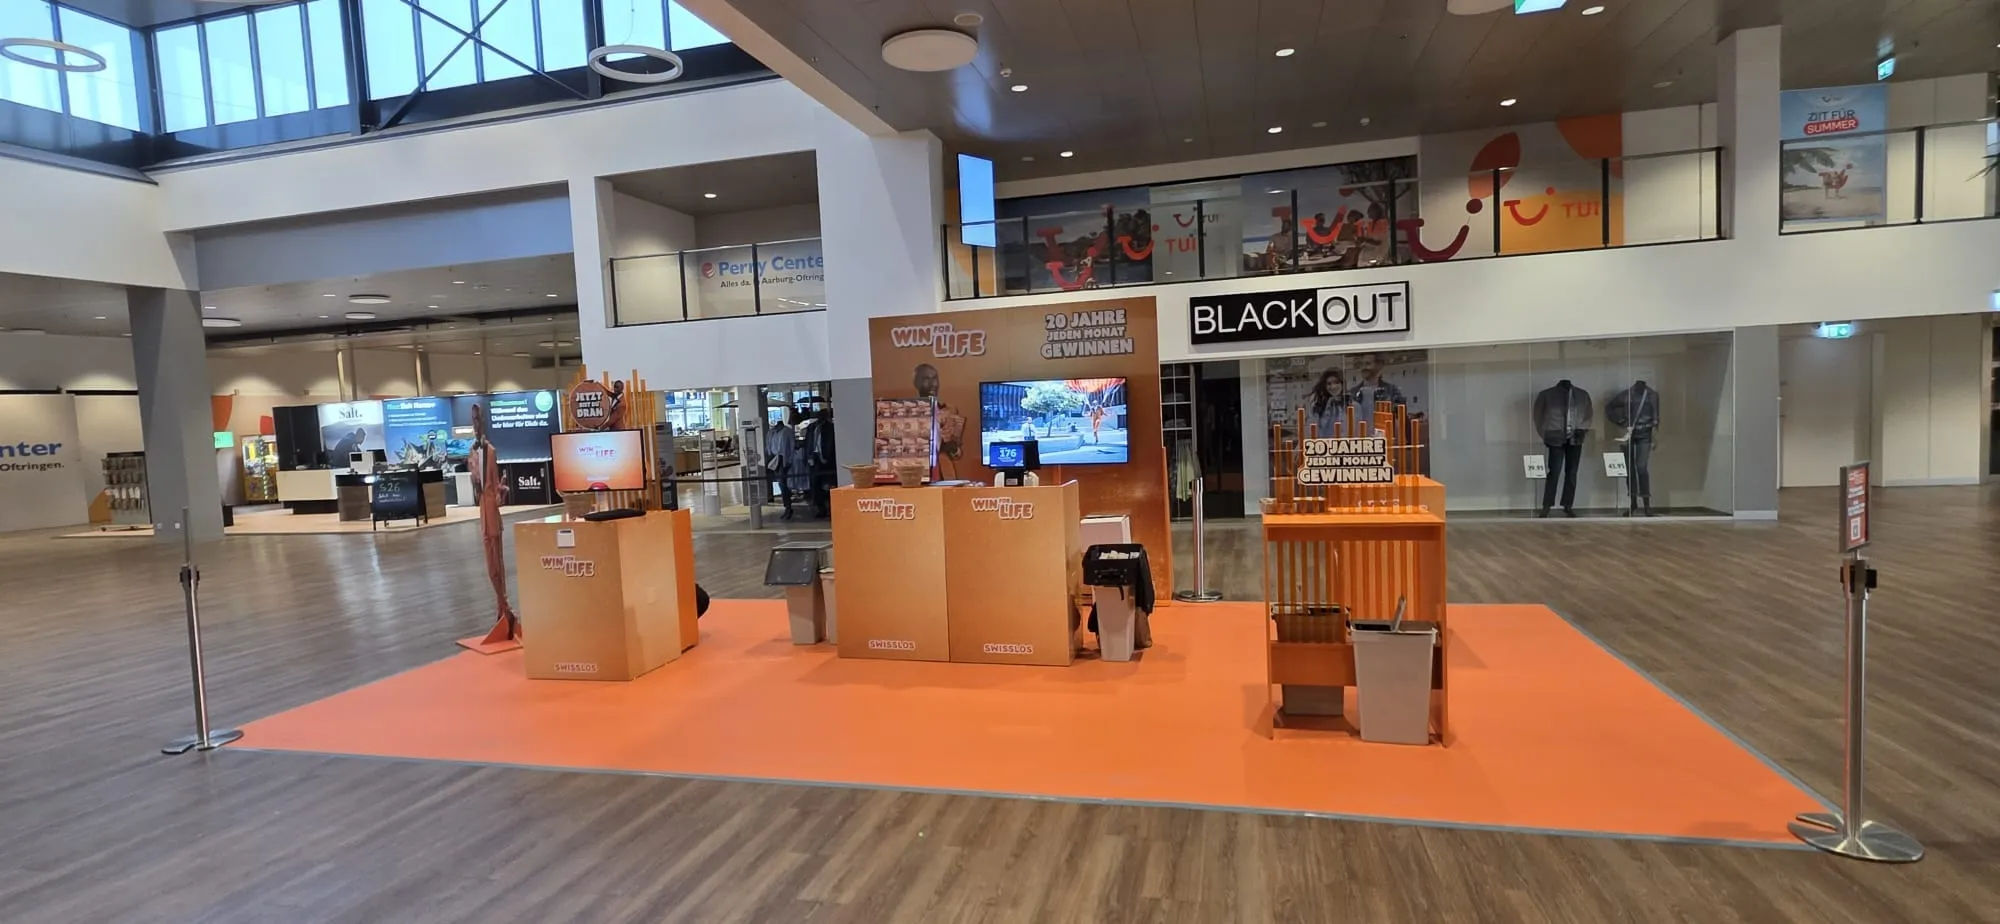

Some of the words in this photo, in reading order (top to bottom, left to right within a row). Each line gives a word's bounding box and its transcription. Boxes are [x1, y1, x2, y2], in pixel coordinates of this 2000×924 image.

[1807, 119, 1857, 134] SUMMER
[1561, 200, 1600, 219] TUI
[1165, 237, 1197, 254] TUI
[720, 280, 739, 288] Alles
[1046, 312, 1067, 329] 20
[1070, 308, 1126, 328] JAHRE
[1047, 329, 1081, 341] JEDEN
[1084, 326, 1126, 338] MONAT
[892, 326, 932, 347] WIN
[933, 331, 985, 357] LIFE
[1041, 338, 1134, 358] GEWINNEN
[575, 391, 602, 402] JETZT
[576, 408, 603, 418] DRAN
[1305, 440, 1327, 455] 20
[1329, 440, 1385, 455] JAHRE
[1307, 456, 1341, 467] JEDEN
[1342, 456, 1384, 466] MONAT
[518, 475, 541, 487] Salt.
[1299, 467, 1392, 483] GEWINNEN
[857, 499, 882, 511] WIN
[882, 504, 914, 519] LIFE
[971, 498, 998, 511] WIN
[998, 503, 1033, 519] LIFE
[540, 556, 564, 569] WIN
[565, 561, 594, 576] LIFE
[869, 640, 915, 650] SWISSLOS
[984, 644, 1033, 654] SWISSLOS
[554, 663, 599, 673] SWISSLOS
